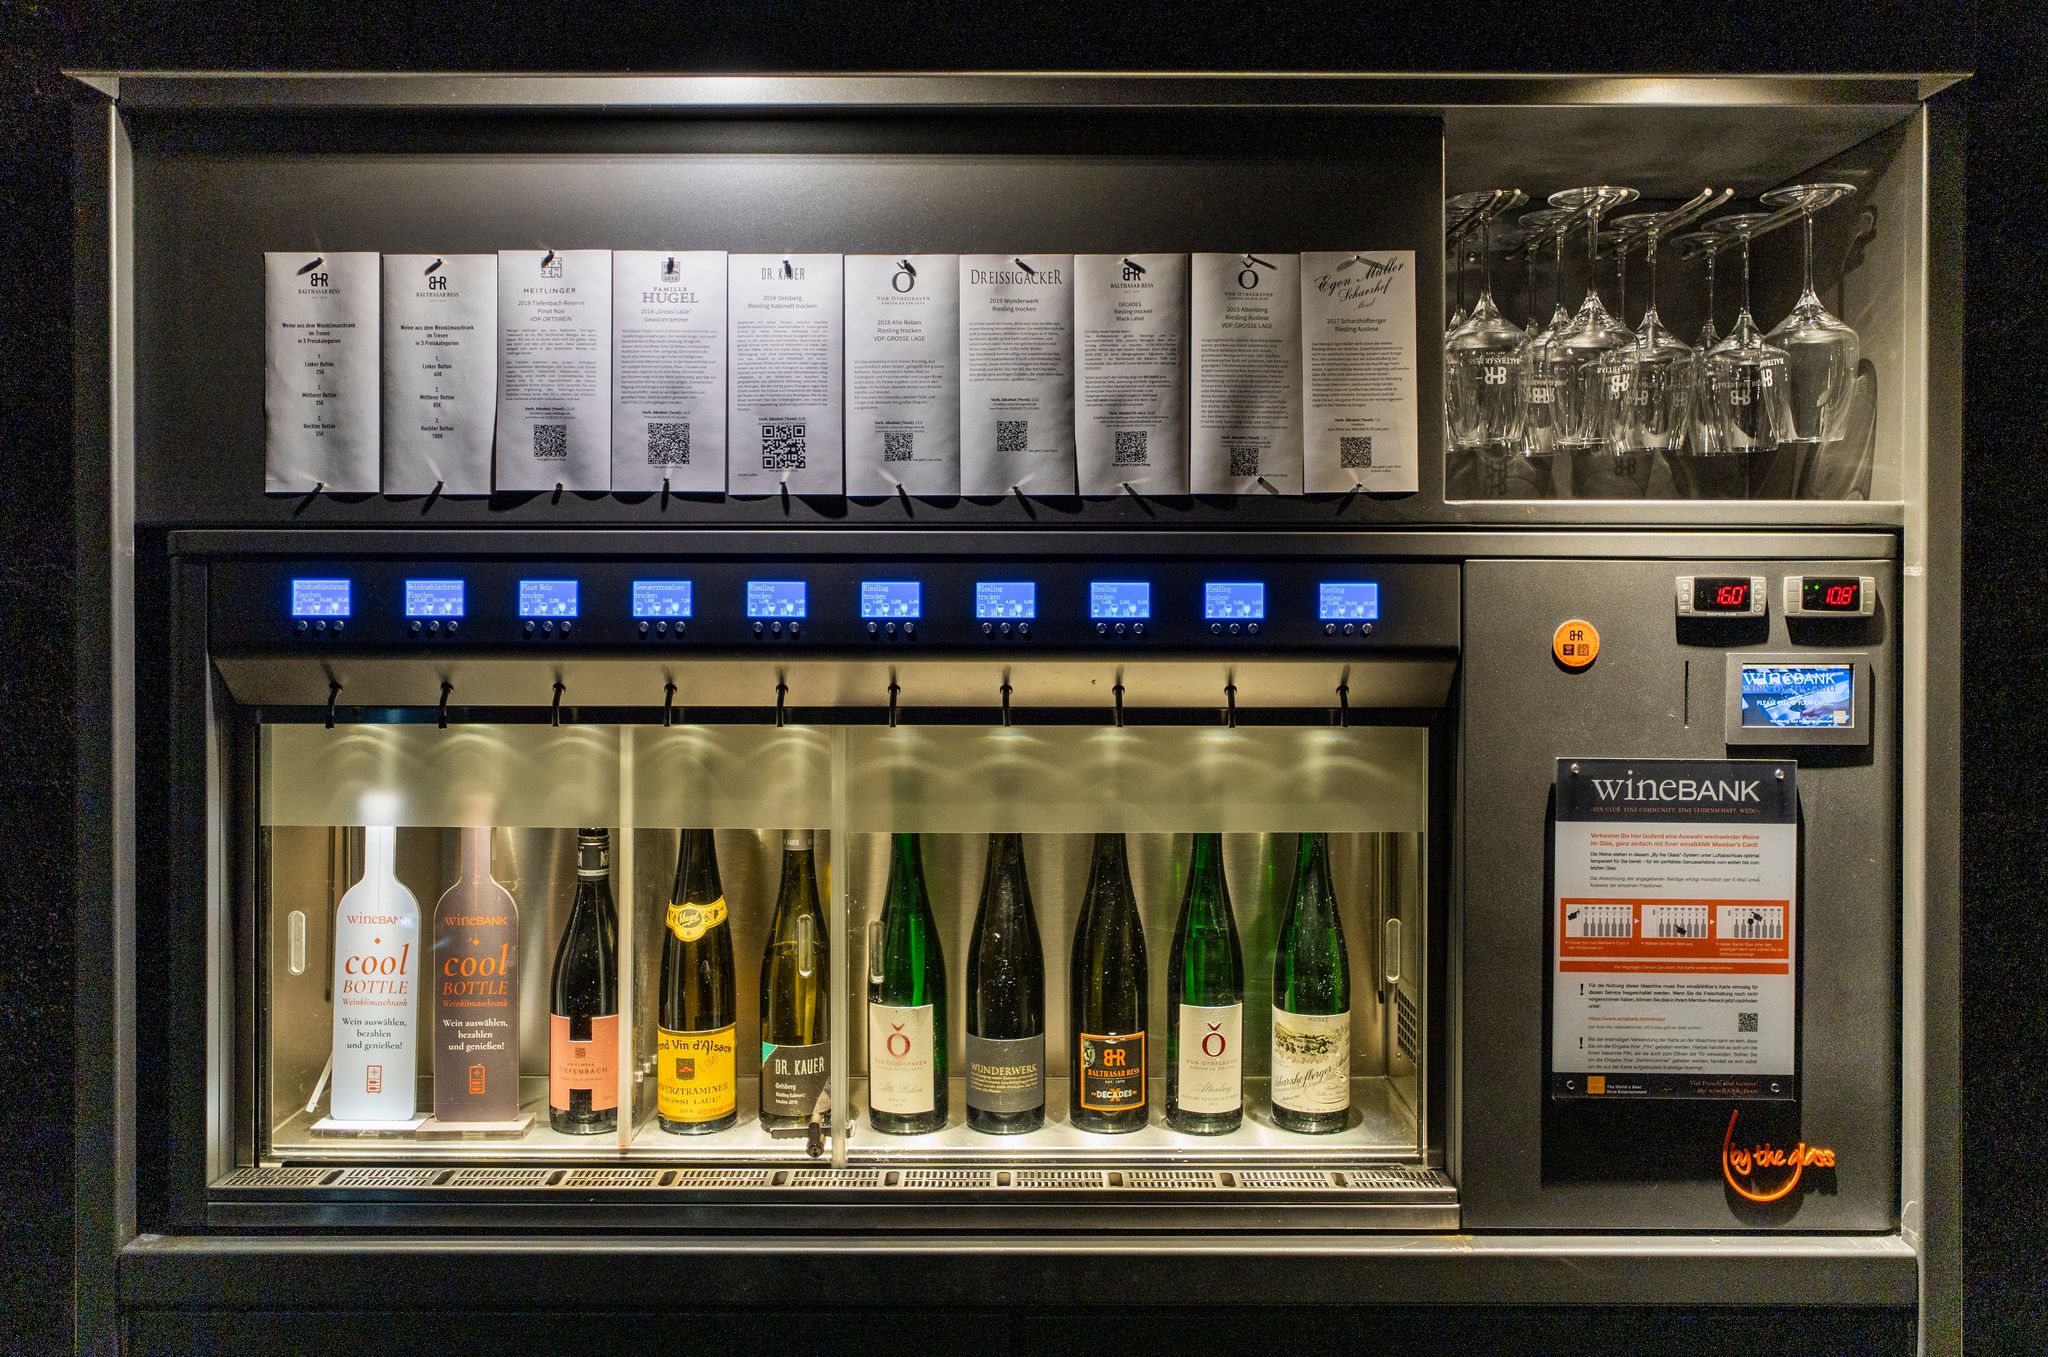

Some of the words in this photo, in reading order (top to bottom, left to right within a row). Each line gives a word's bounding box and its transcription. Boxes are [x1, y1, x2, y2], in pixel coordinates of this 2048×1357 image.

[762, 268, 776, 280] DR.
[971, 269, 1062, 284] DREISSIGACKER
[1314, 274, 1351, 296] Egon
[1357, 256, 1404, 282] Müller
[1338, 276, 1393, 302] Scharzhof
[642, 292, 699, 304] HUGEL
[750, 584, 775, 592] Riesling
[1092, 585, 1117, 593] Riesling
[1320, 586, 1344, 594] Riesling
[1742, 671, 1836, 686] wineBANK
[1592, 769, 1760, 802] wineBANK
[445, 912, 508, 926] wineBANK
[345, 943, 410, 977] cool
[444, 943, 508, 977] cool
[344, 980, 408, 995] BOTTLE
[442, 980, 508, 996] BOTTLE
[342, 998, 408, 1008] Weinklimaschrank
[442, 998, 508, 1008] Weinklimaschrank
[342, 1018, 362, 1026] Wein
[364, 1018, 406, 1027] auswählen,
[442, 1018, 463, 1027] Wein
[464, 1018, 508, 1028] auswählen,
[356, 1028, 392, 1038] bezahlen
[458, 1030, 493, 1039] bezahlen
[364, 1042, 402, 1052] genießen!
[466, 1042, 505, 1052] genießen!
[672, 1040, 688, 1050] Vin
[692, 1040, 732, 1056] d'Alsace
[560, 1066, 608, 1074] TIEFENBACH
[776, 1058, 790, 1076] DR.
[794, 1056, 824, 1076] KAUER
[970, 1061, 1038, 1076] WUNDERWERK
[1088, 1068, 1126, 1078] BALTHASAR
[1126, 1067, 1140, 1076] RESS
[775, 1082, 796, 1092] Oelsberg
[1096, 1090, 1132, 1099] DECADES
[1730, 1142, 1752, 1176] by
[1752, 1142, 1786, 1168] the
